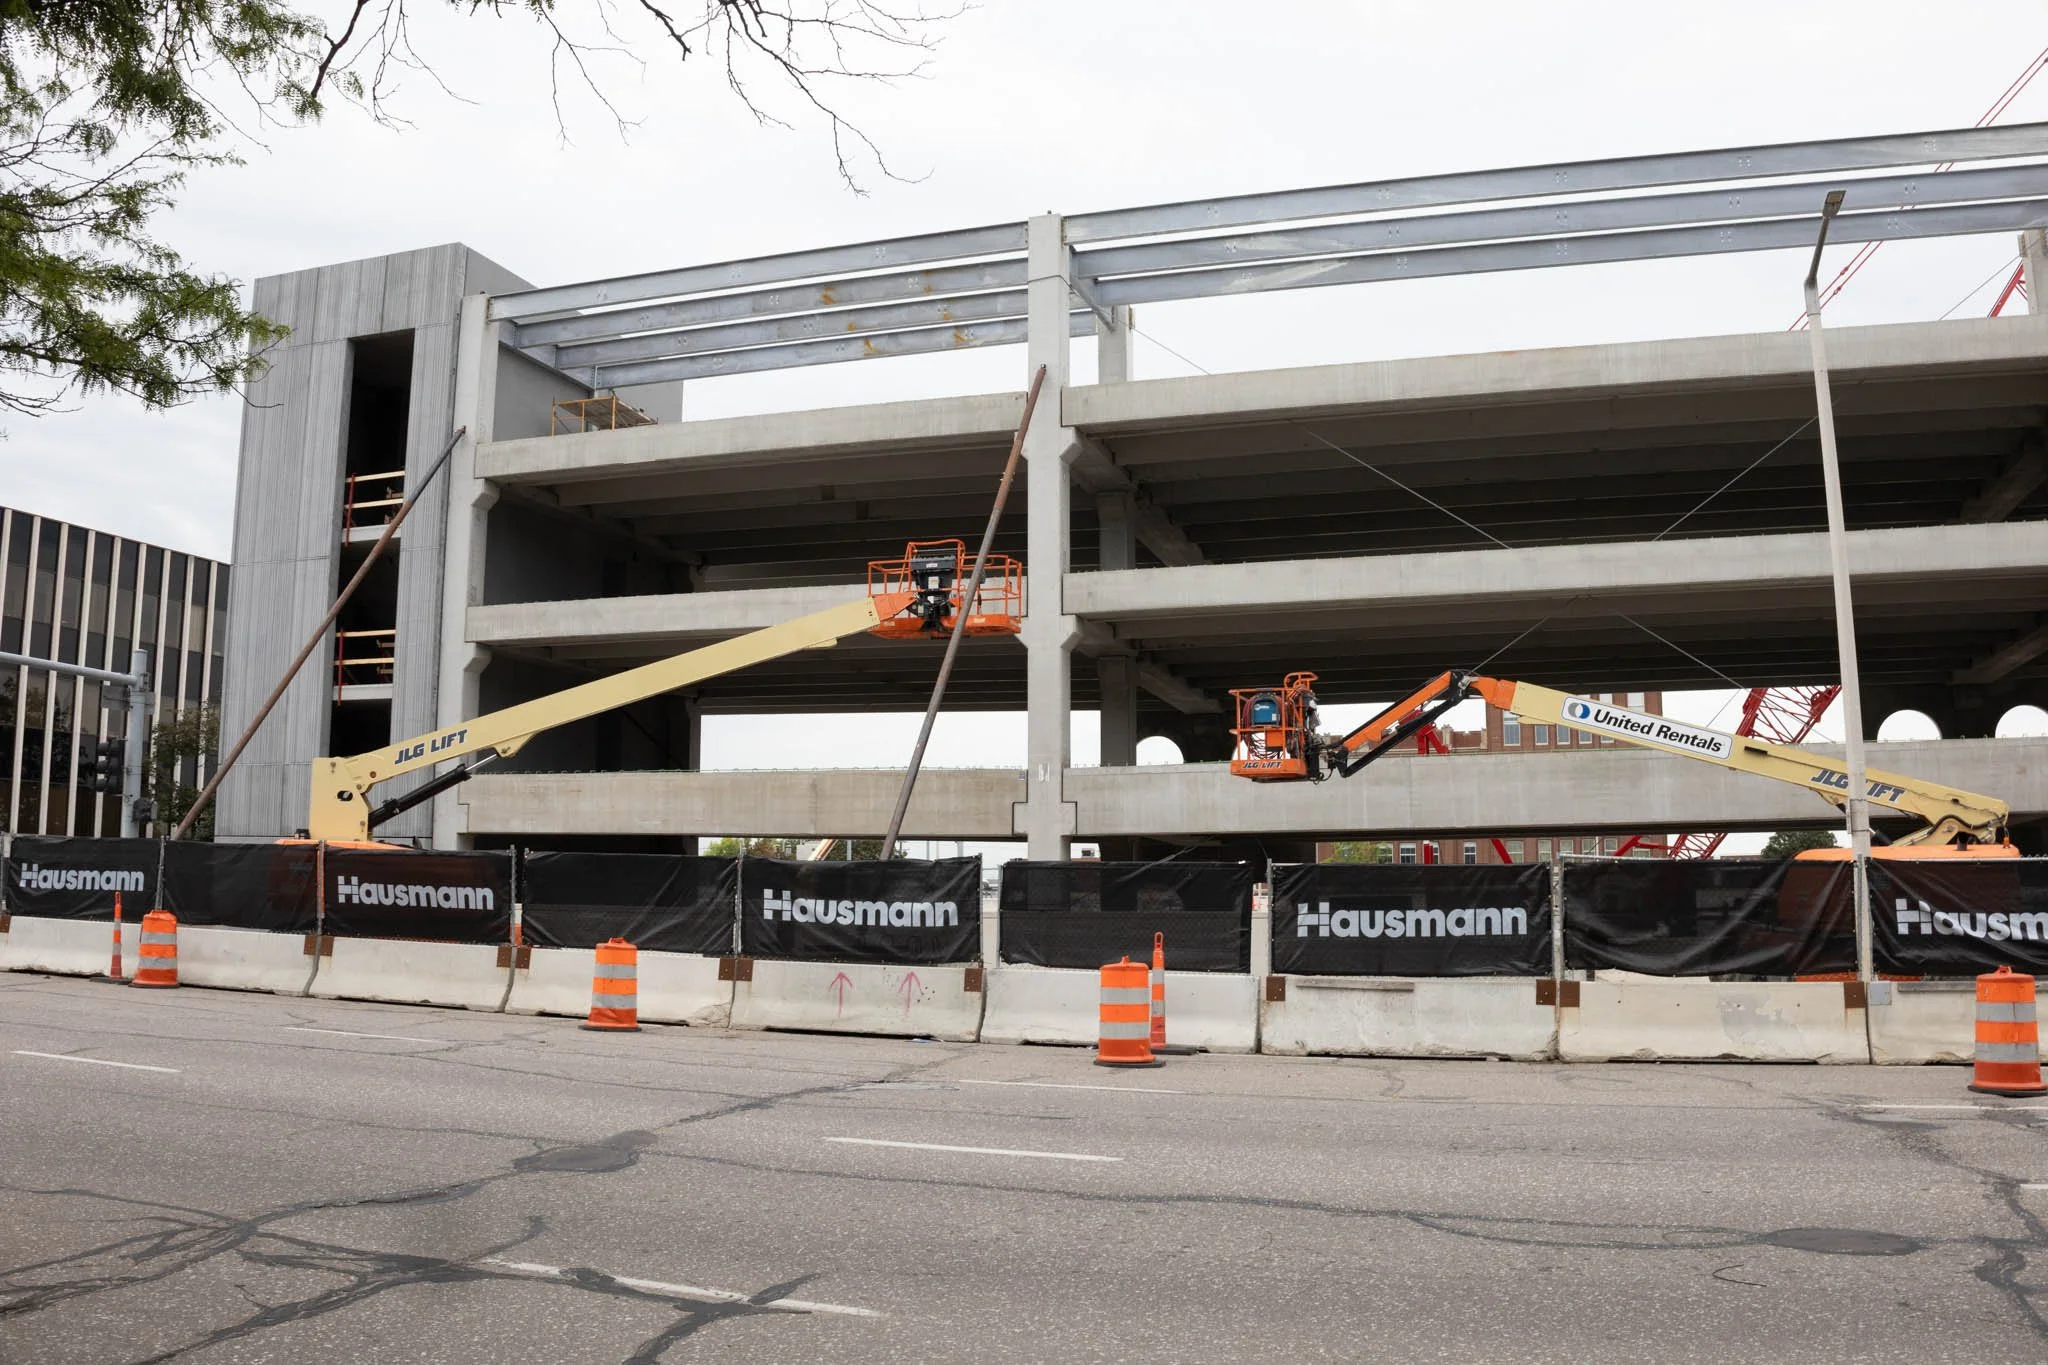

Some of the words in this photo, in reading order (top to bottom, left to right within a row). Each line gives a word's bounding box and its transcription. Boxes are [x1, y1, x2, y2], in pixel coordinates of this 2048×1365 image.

[394, 742, 425, 765] JLG
[430, 729, 468, 753] LIFT
[1593, 708, 1654, 736] United
[1656, 723, 1723, 753] Rentals
[1242, 761, 1259, 769] JLG
[1261, 761, 1282, 769] LIFT
[1811, 767, 1849, 789] JLG
[1863, 780, 1905, 802] IFT
[19, 862, 145, 892] Hausmann
[337, 875, 494, 911] Hausmann
[763, 888, 959, 927] Hausmann
[1297, 901, 1527, 938] Hausmann
